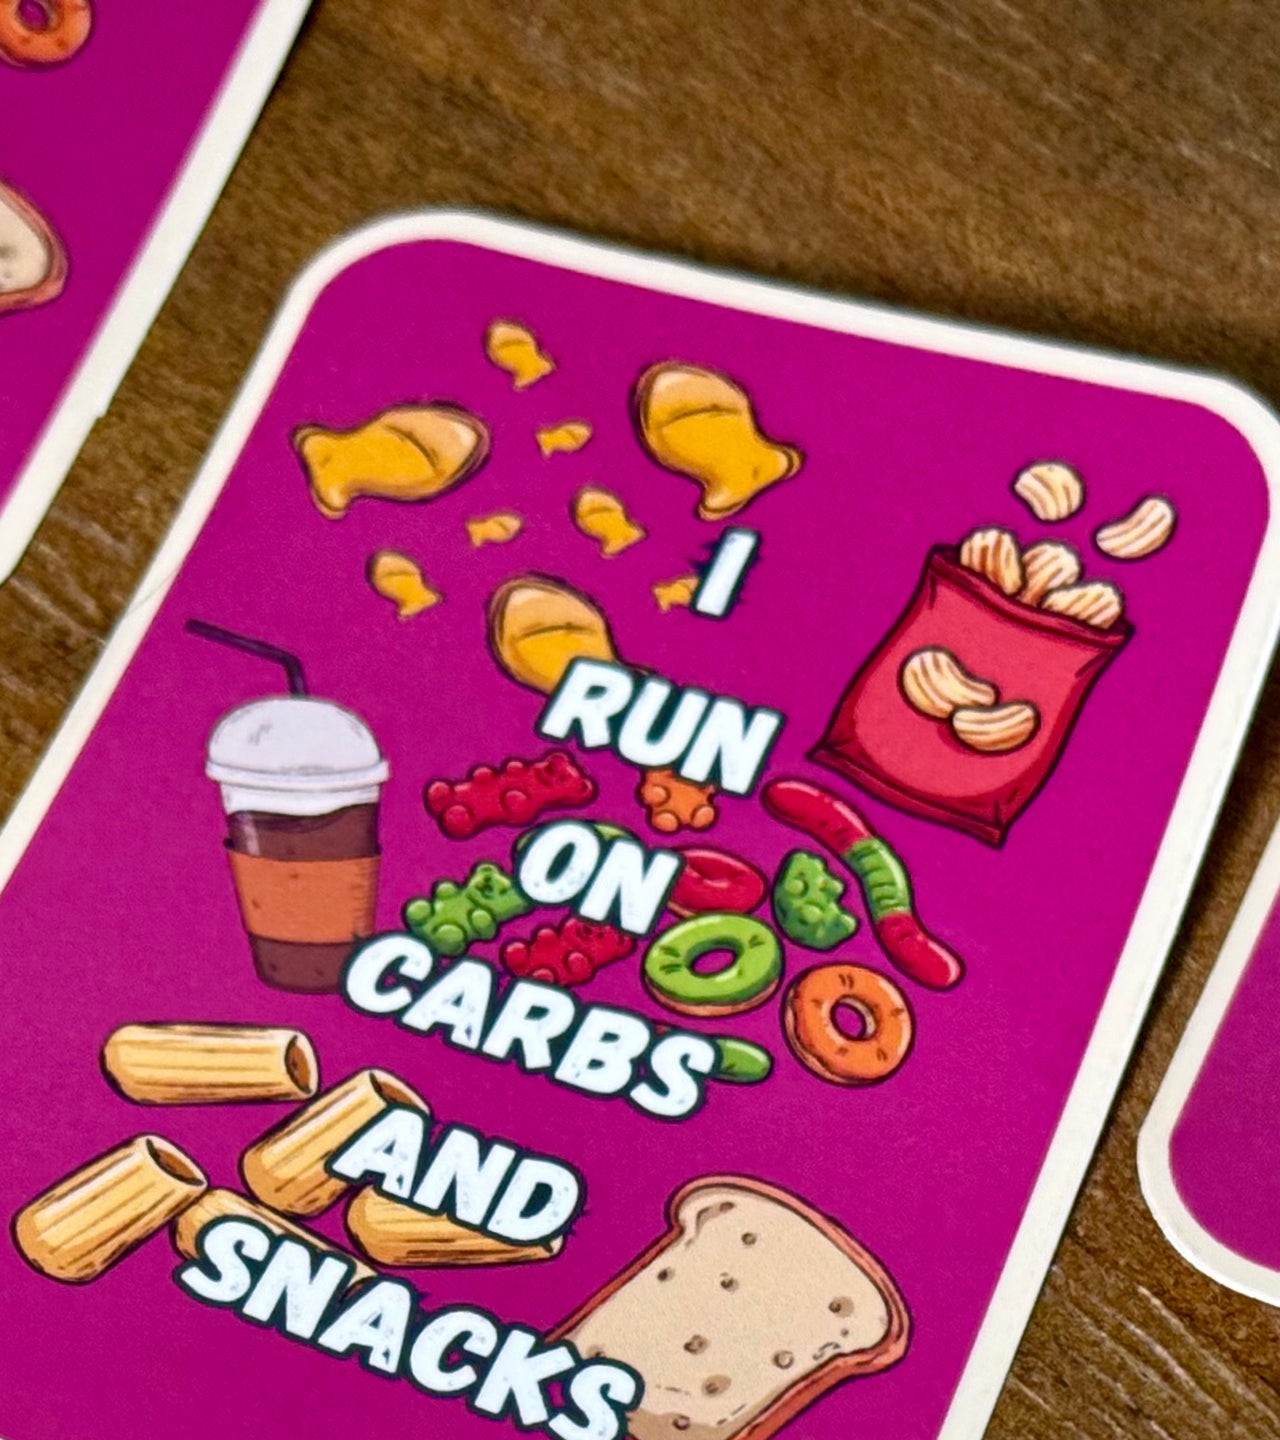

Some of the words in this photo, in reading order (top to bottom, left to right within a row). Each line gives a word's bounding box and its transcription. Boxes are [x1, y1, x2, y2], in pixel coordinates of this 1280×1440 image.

[698, 533, 754, 614] I
[543, 662, 778, 793] RUN
[520, 824, 678, 933] ON
[347, 936, 714, 1115] CARBS
[333, 1110, 578, 1240] AND
